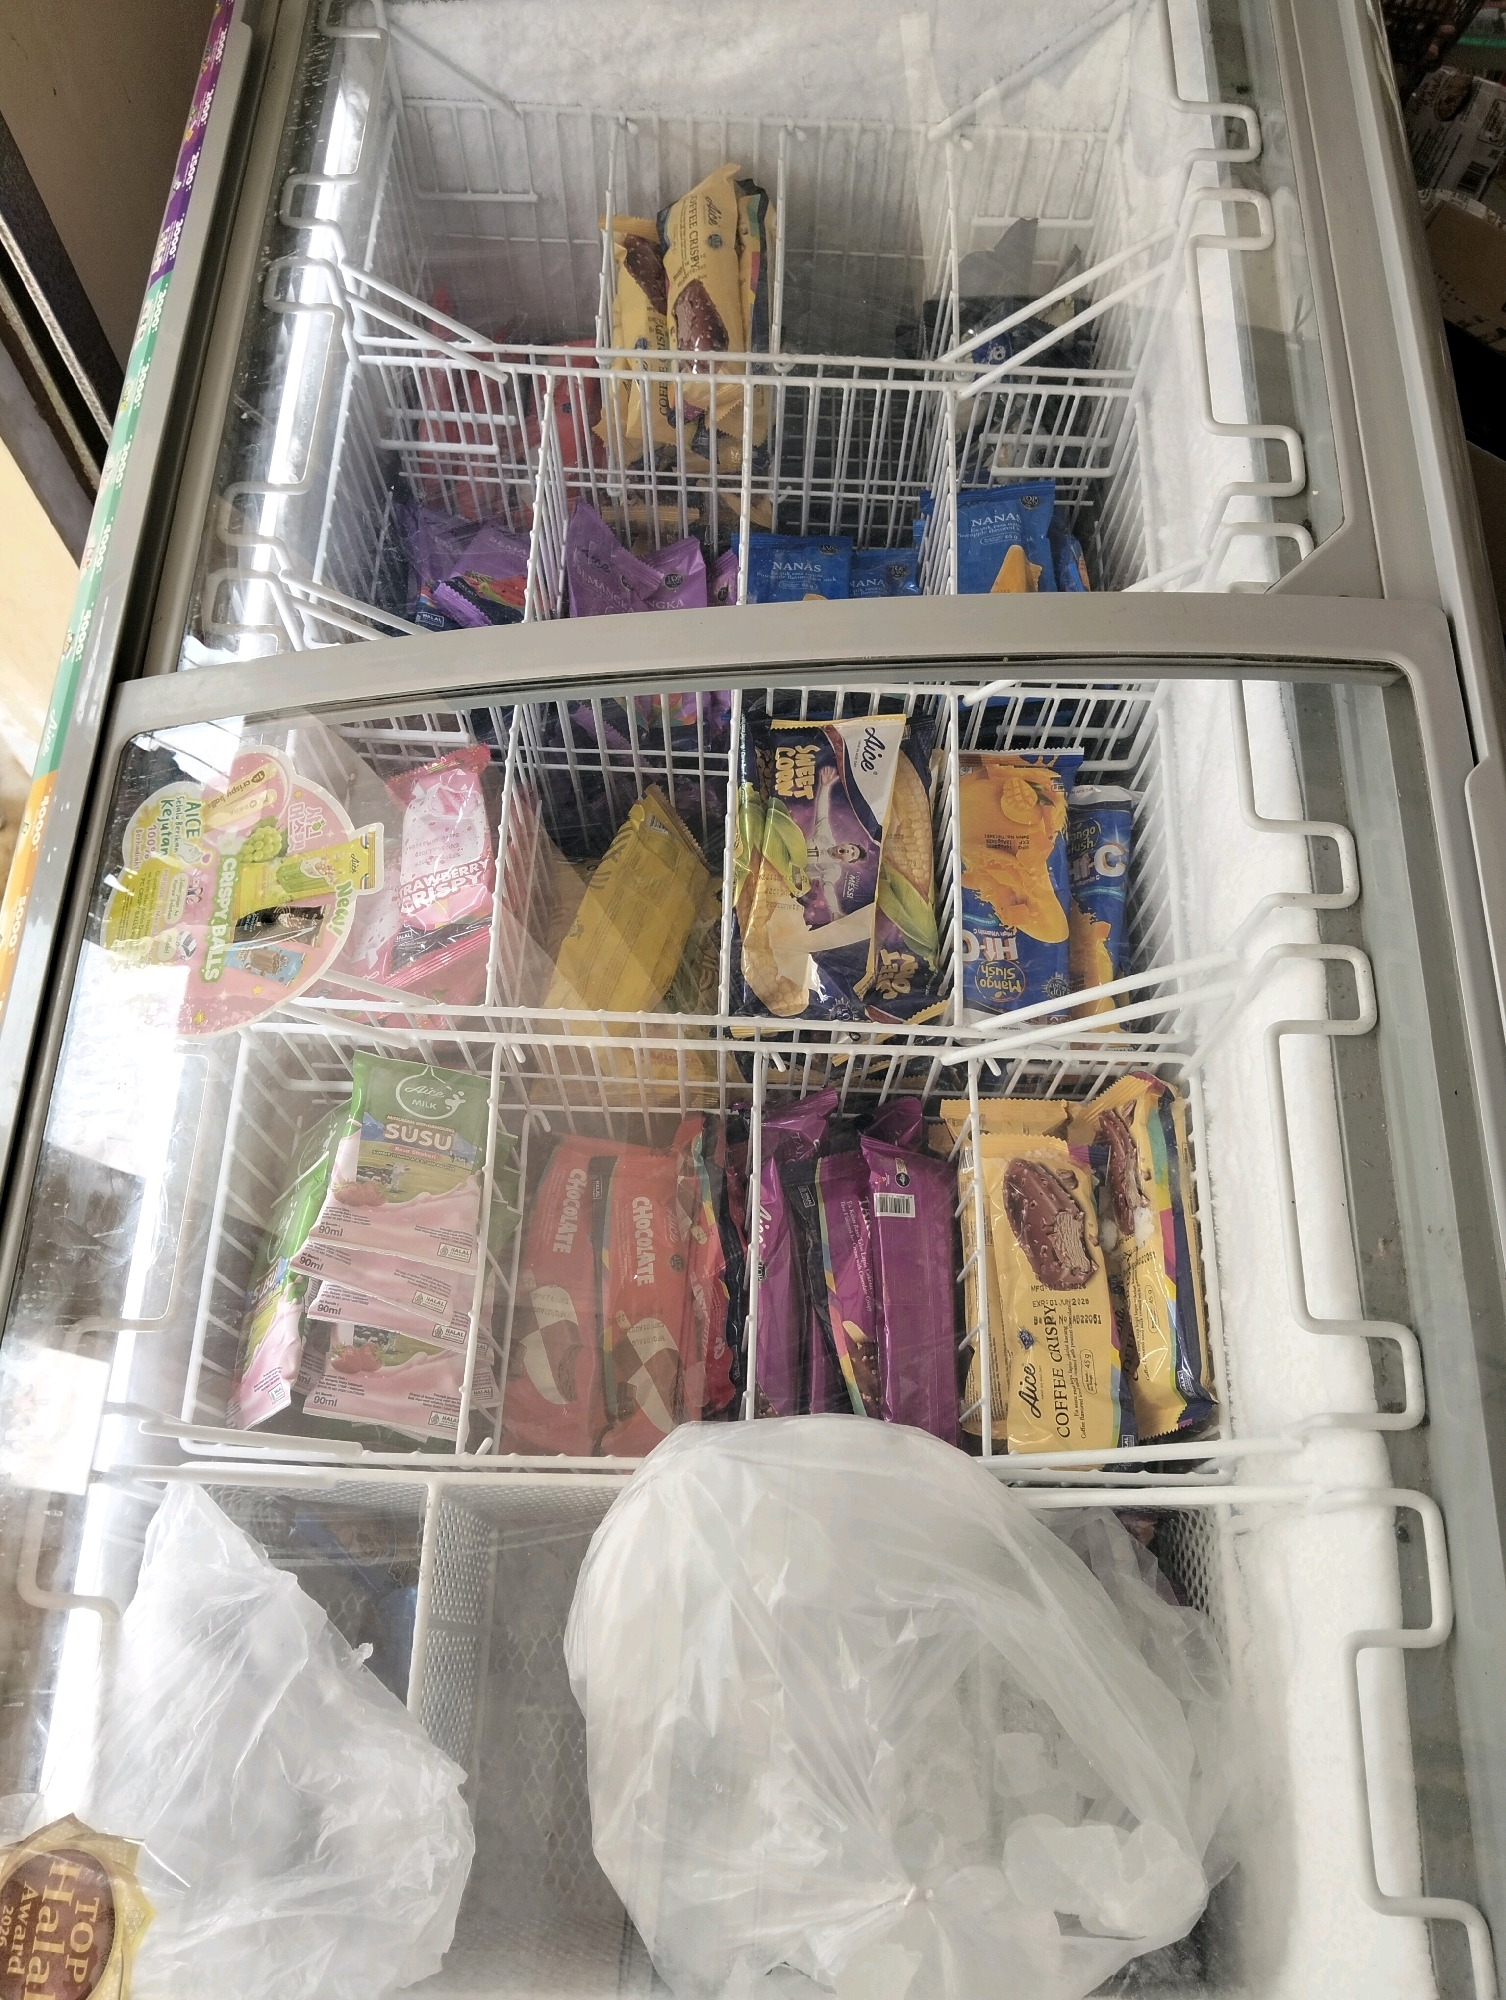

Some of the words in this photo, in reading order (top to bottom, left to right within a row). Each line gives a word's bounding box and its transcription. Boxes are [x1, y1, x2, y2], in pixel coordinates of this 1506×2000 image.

[705, 196, 721, 226] Aice
[772, 561, 821, 573] NANAS
[646, 598, 685, 610] NGKA
[861, 727, 886, 773] Aice
[774, 747, 795, 797] CORN
[793, 744, 821, 800] SWEET
[227, 780, 250, 797] crispy
[175, 796, 184, 819] Selalu
[185, 801, 201, 838] AICE
[144, 825, 157, 859] 100%
[157, 799, 175, 856] Kejutan
[174, 821, 183, 852] Berikan
[214, 857, 237, 920] CRISPY
[400, 871, 482, 914] CRISPY
[846, 874, 856, 899] MESSI
[328, 881, 353, 936] New!
[204, 924, 227, 981] BALLS
[980, 976, 1022, 993] Mango
[981, 965, 1016, 980] Slush
[405, 1085, 444, 1098] Aice
[412, 1099, 437, 1110] MILK
[384, 1123, 453, 1151] SUSU
[395, 1146, 410, 1154] Rasa
[553, 1167, 587, 1254] CHOCOLATE
[319, 1225, 343, 1237] 90ml
[631, 1196, 656, 1287] CHOCOLATE
[300, 1256, 324, 1271] 90ml
[450, 1247, 470, 1256] HALAL
[317, 1304, 342, 1315] 90ml
[426, 1296, 445, 1306] HALAL
[445, 1328, 464, 1337] HALAL
[1044, 1307, 1063, 1361] CRISPY
[313, 1395, 338, 1407] 90ml
[1017, 1363, 1042, 1419] Aice
[1052, 1369, 1070, 1437] COFFEE
[7, 1881, 39, 1976] Award
[66, 1897, 100, 1983] TOP
